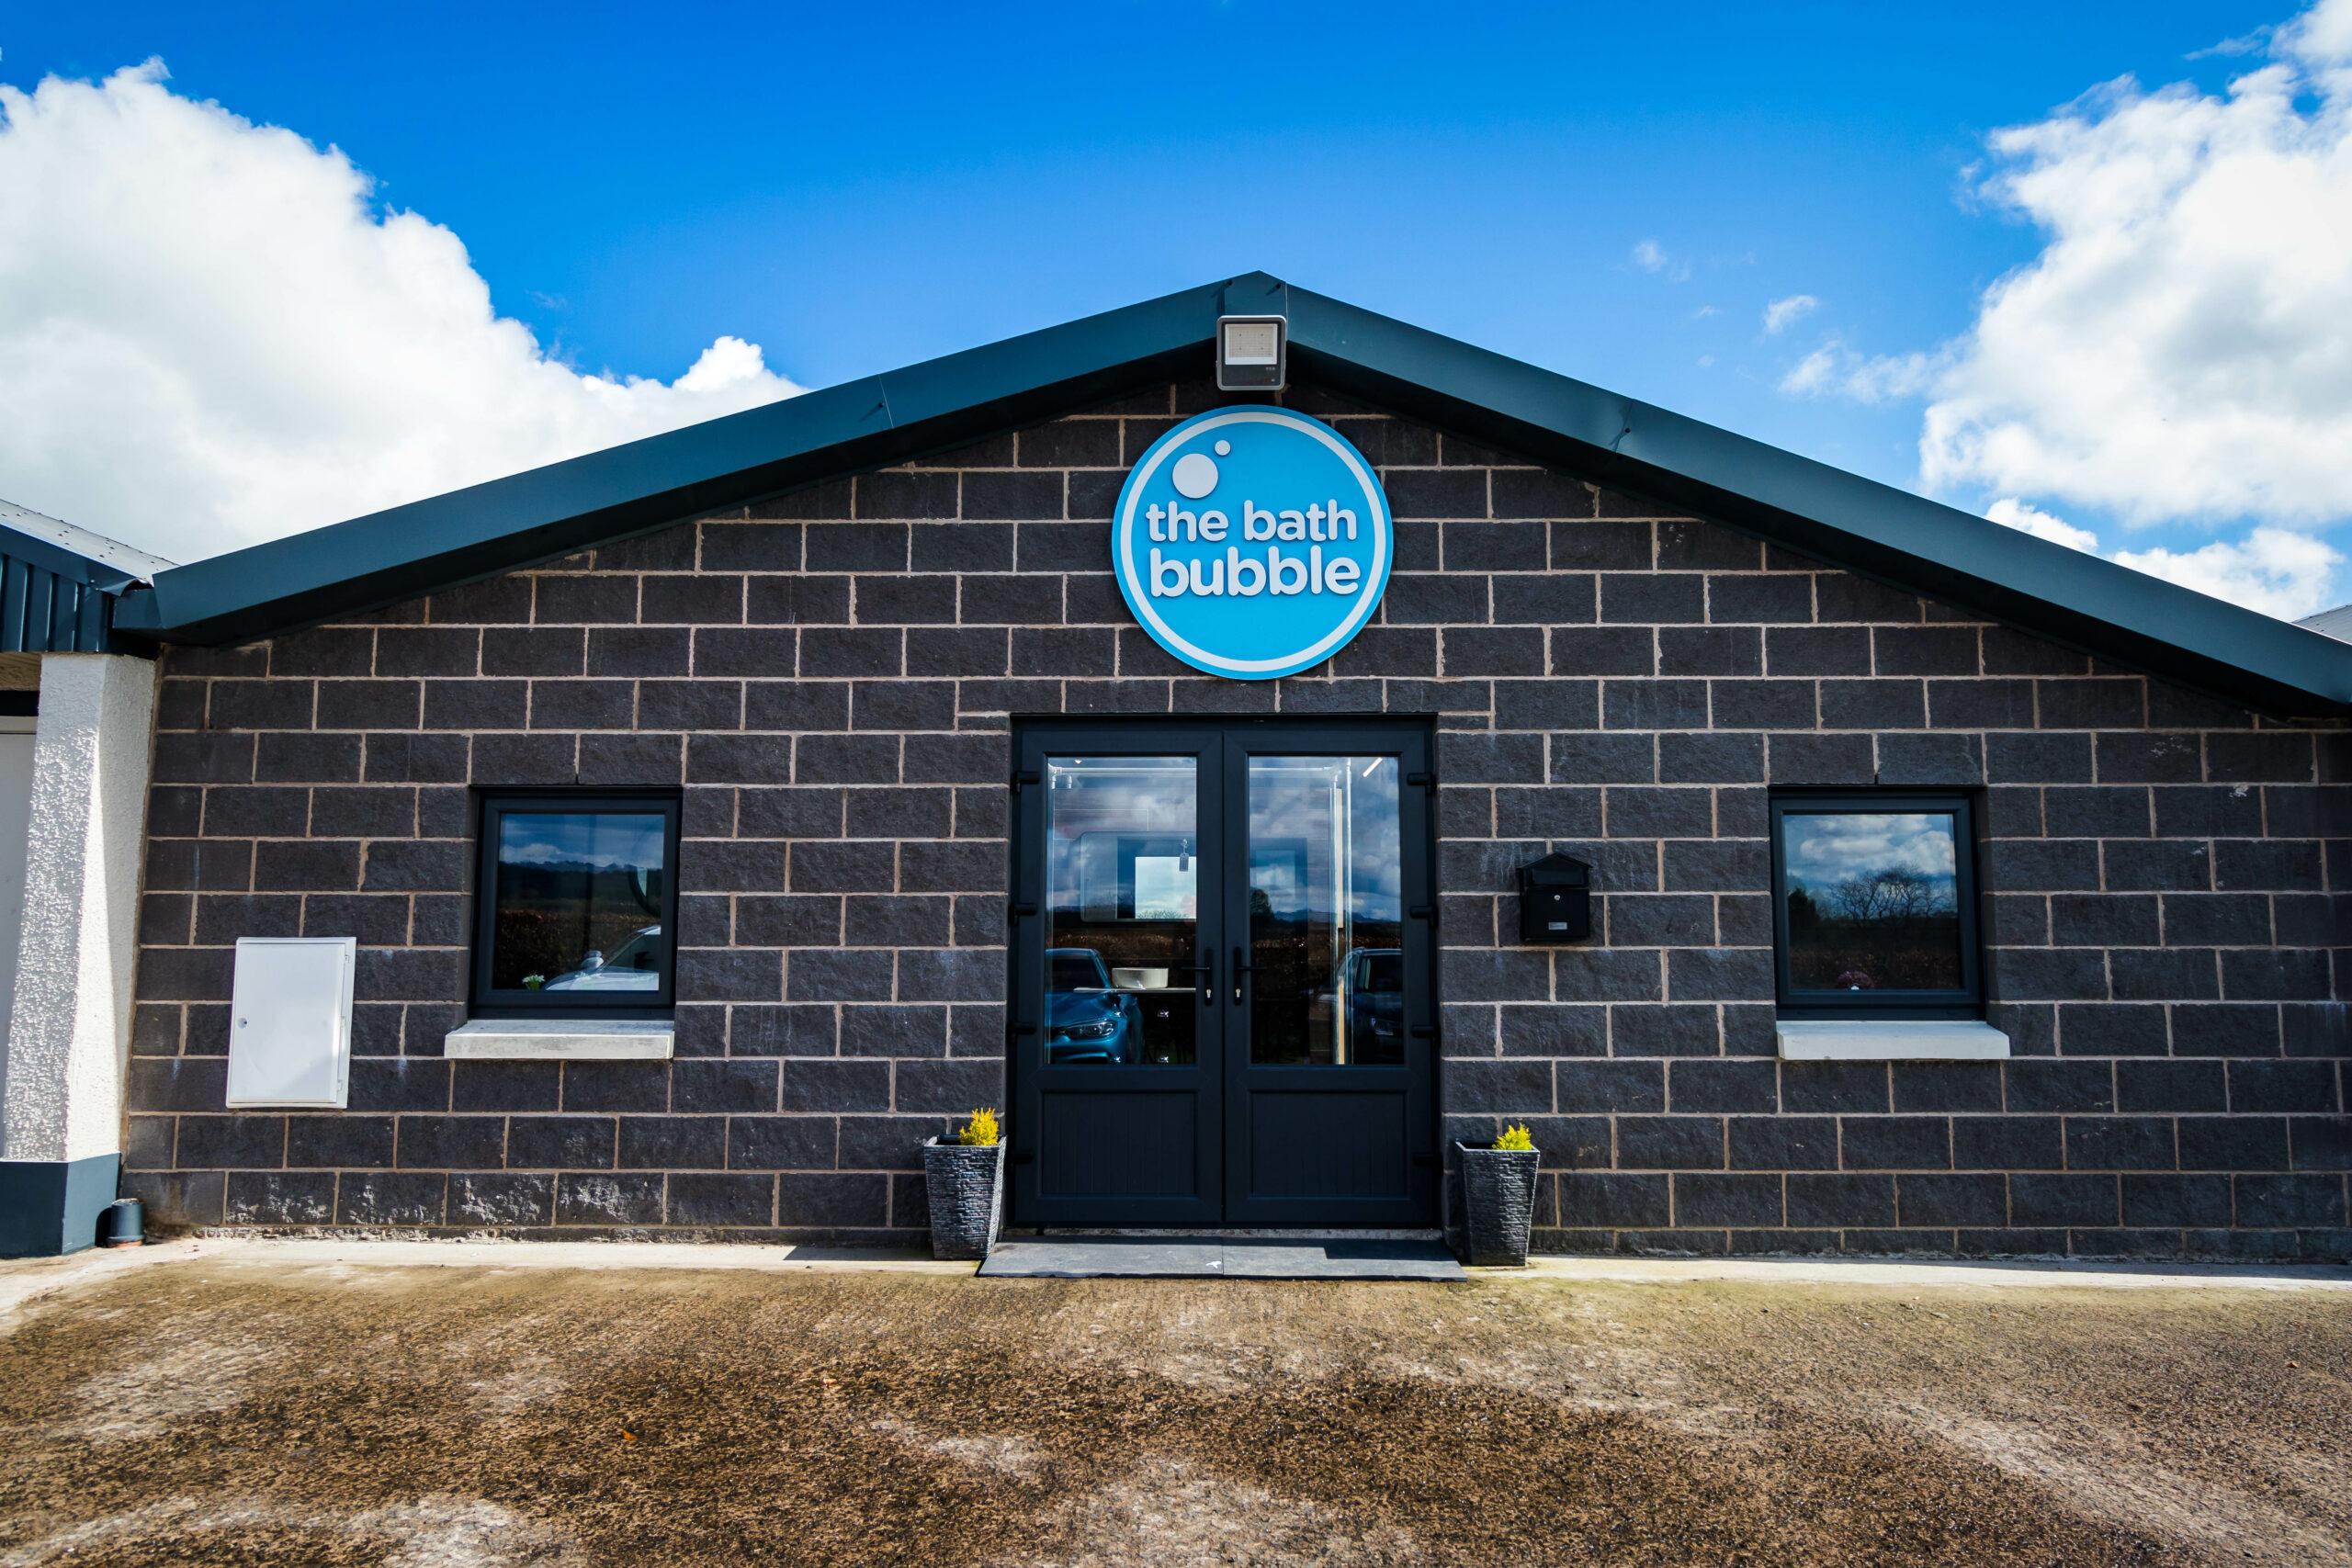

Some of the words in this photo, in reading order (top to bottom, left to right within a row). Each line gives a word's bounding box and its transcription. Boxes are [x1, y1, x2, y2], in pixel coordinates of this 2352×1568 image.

[1145, 501, 1229, 542] the
[1244, 499, 1357, 542] bath
[1149, 545, 1361, 597] bubble
